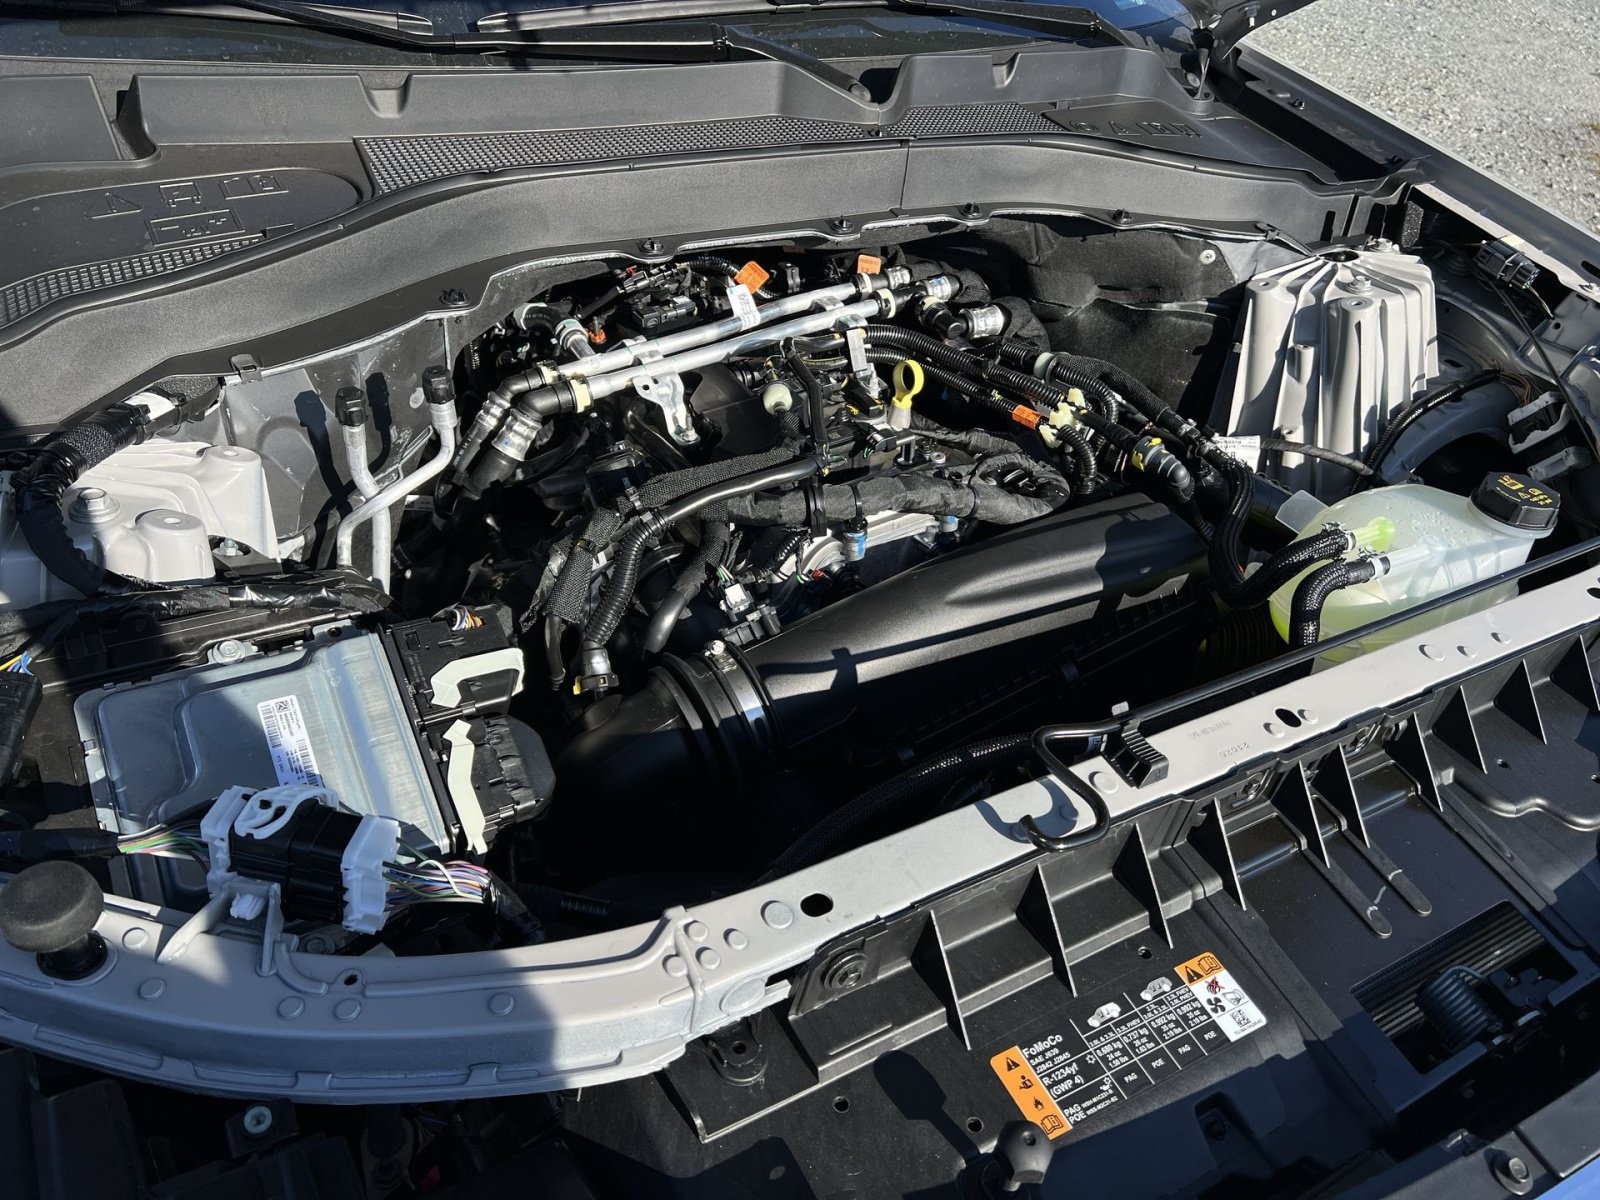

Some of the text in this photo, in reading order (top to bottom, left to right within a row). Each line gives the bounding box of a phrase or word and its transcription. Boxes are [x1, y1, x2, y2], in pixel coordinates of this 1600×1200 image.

[1176, 1003, 1193, 1016] 0.992
[1126, 1018, 1140, 1028] FHEV
[1150, 1016, 1168, 1028] 0.992
[1188, 1017, 1200, 1026] 2.19
[1089, 1039, 1100, 1047] 3.0L
[1104, 1032, 1116, 1040] 3.3L
[1122, 1030, 1139, 1043] 0.737
[1162, 1030, 1175, 1040] 2.19
[1204, 1030, 1217, 1041] POE
[1022, 1034, 1062, 1058] FoMoCo
[1132, 1039, 1141, 1047] 26
[1178, 1044, 1191, 1054] PAG
[1096, 1044, 1114, 1056] 0.680
[1136, 1045, 1148, 1054] 1.63
[1030, 1048, 1059, 1066] SAE J639
[1036, 1052, 1070, 1074] J2842 J2845
[1151, 1058, 1164, 1068] POE
[1108, 1059, 1120, 1068] 1.50
[1042, 1062, 1078, 1086] R-1234yf
[1124, 1072, 1138, 1083] PAG
[1050, 1074, 1084, 1098] (GWP 4)
[1064, 1104, 1081, 1116] PAG
[1068, 1110, 1086, 1124] POE
